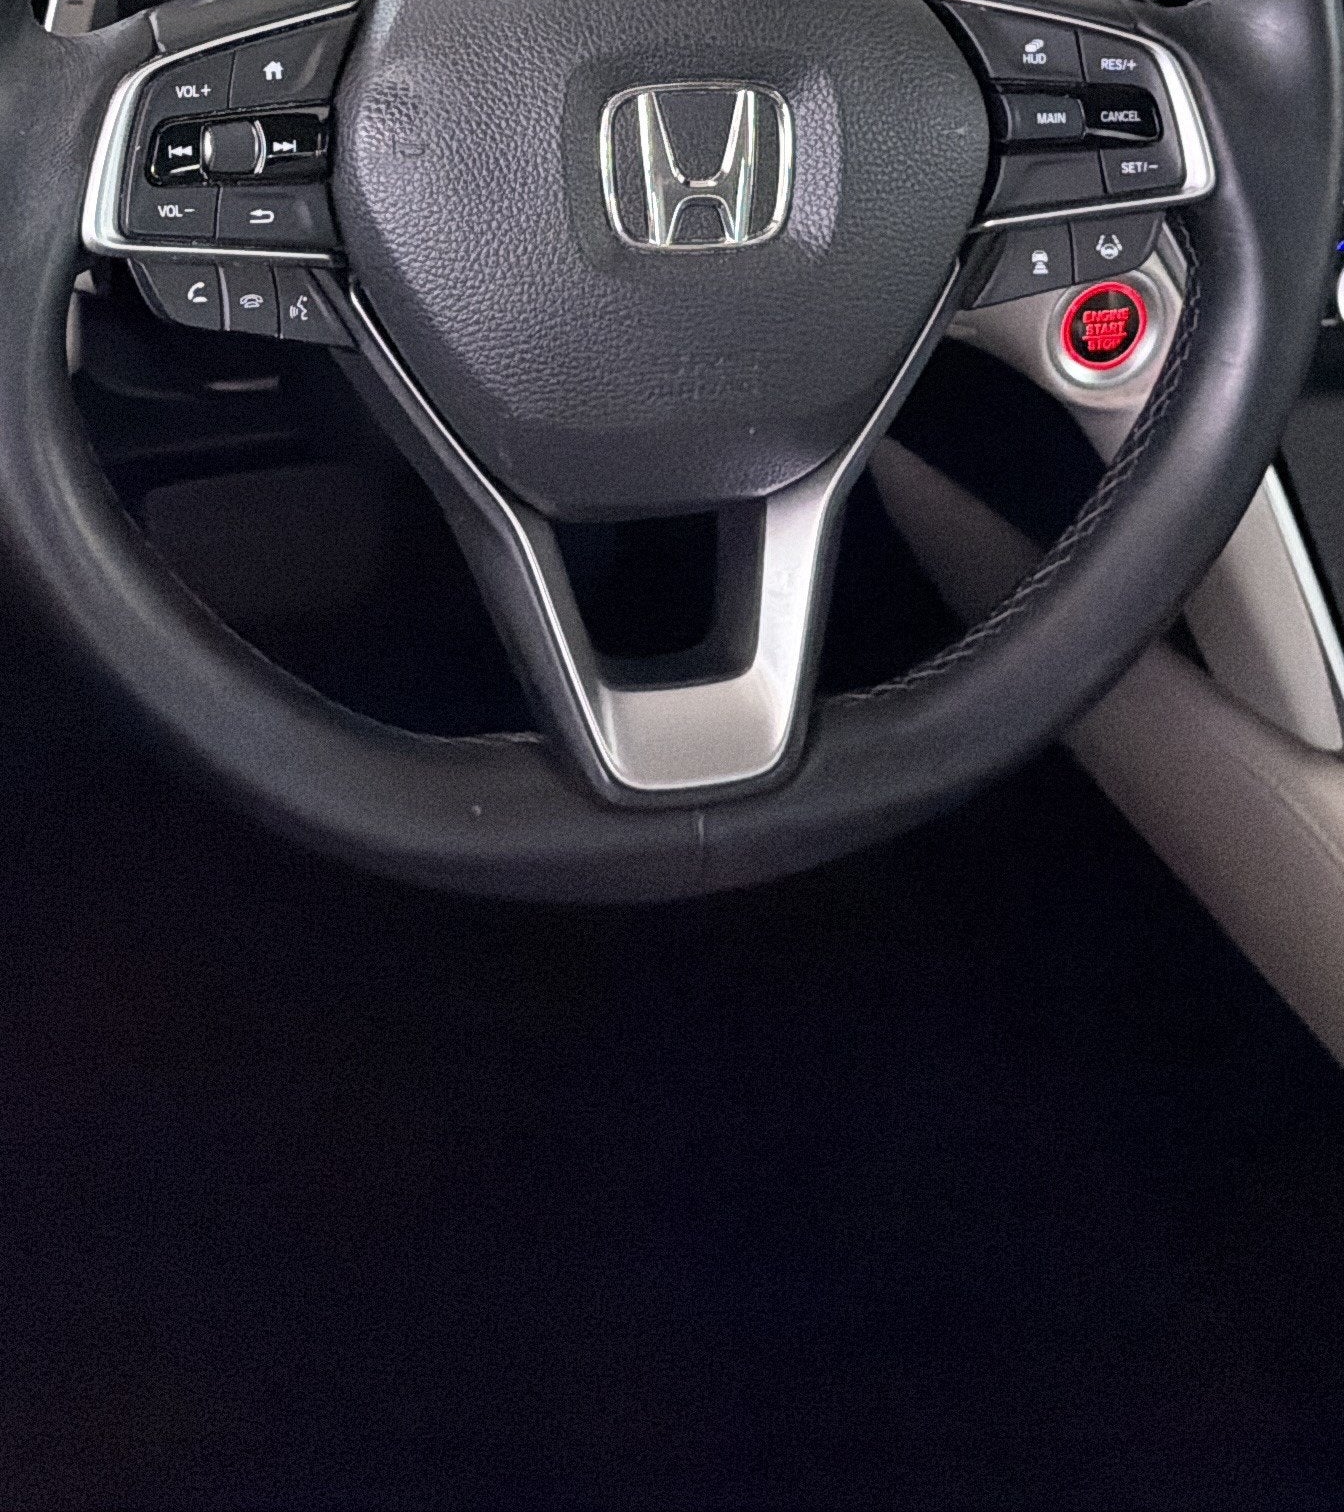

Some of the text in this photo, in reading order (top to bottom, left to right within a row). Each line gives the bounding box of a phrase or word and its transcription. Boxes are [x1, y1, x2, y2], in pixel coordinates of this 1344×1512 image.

[1022, 53, 1047, 65] HUD
[1036, 112, 1067, 125] MAIN
[1100, 110, 1141, 123] CANCEL
[1083, 307, 1130, 324] ENGINE
[1086, 321, 1126, 336] START
